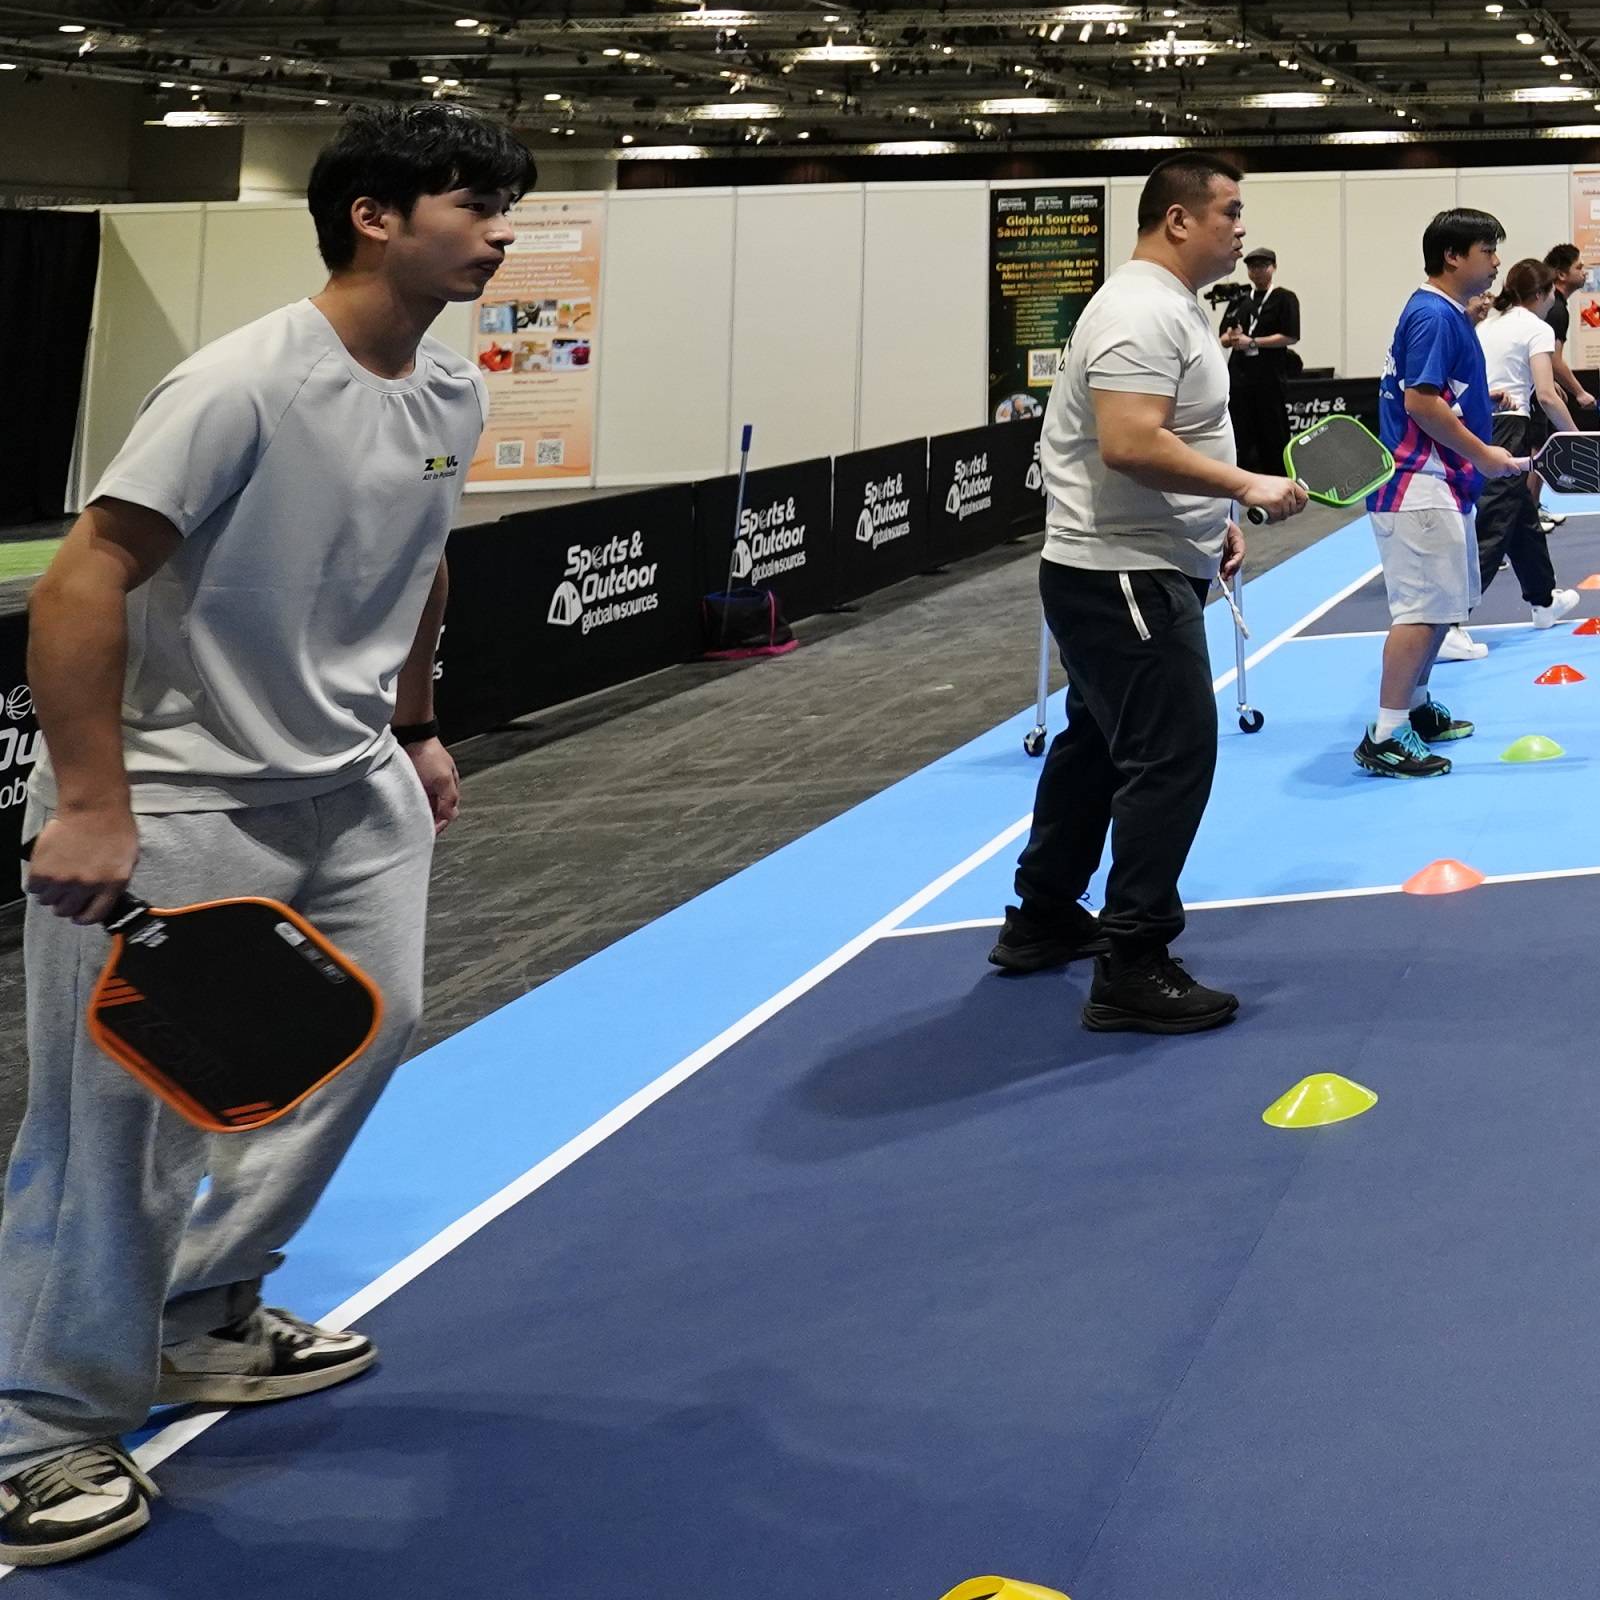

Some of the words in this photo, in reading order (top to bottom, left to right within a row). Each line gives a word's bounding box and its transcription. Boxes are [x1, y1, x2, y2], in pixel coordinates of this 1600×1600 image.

[997, 225, 1028, 238] Saudi
[1031, 224, 1067, 236] Arabia
[1070, 223, 1098, 236] Expo
[1006, 214, 1043, 226] Global
[1046, 213, 1089, 225] Sources
[1333, 396, 1346, 412] &
[864, 476, 895, 508] Sports
[896, 473, 903, 495] &
[960, 475, 993, 501] Outdoor
[739, 501, 785, 539] Sports
[785, 496, 796, 522] &
[872, 499, 910, 527] Outdoor
[564, 535, 629, 581] Sports
[629, 530, 643, 559] &
[752, 525, 806, 560] Outdoor
[582, 563, 658, 604] Outdoor
[581, 603, 613, 635] global
[620, 593, 658, 619] sources
